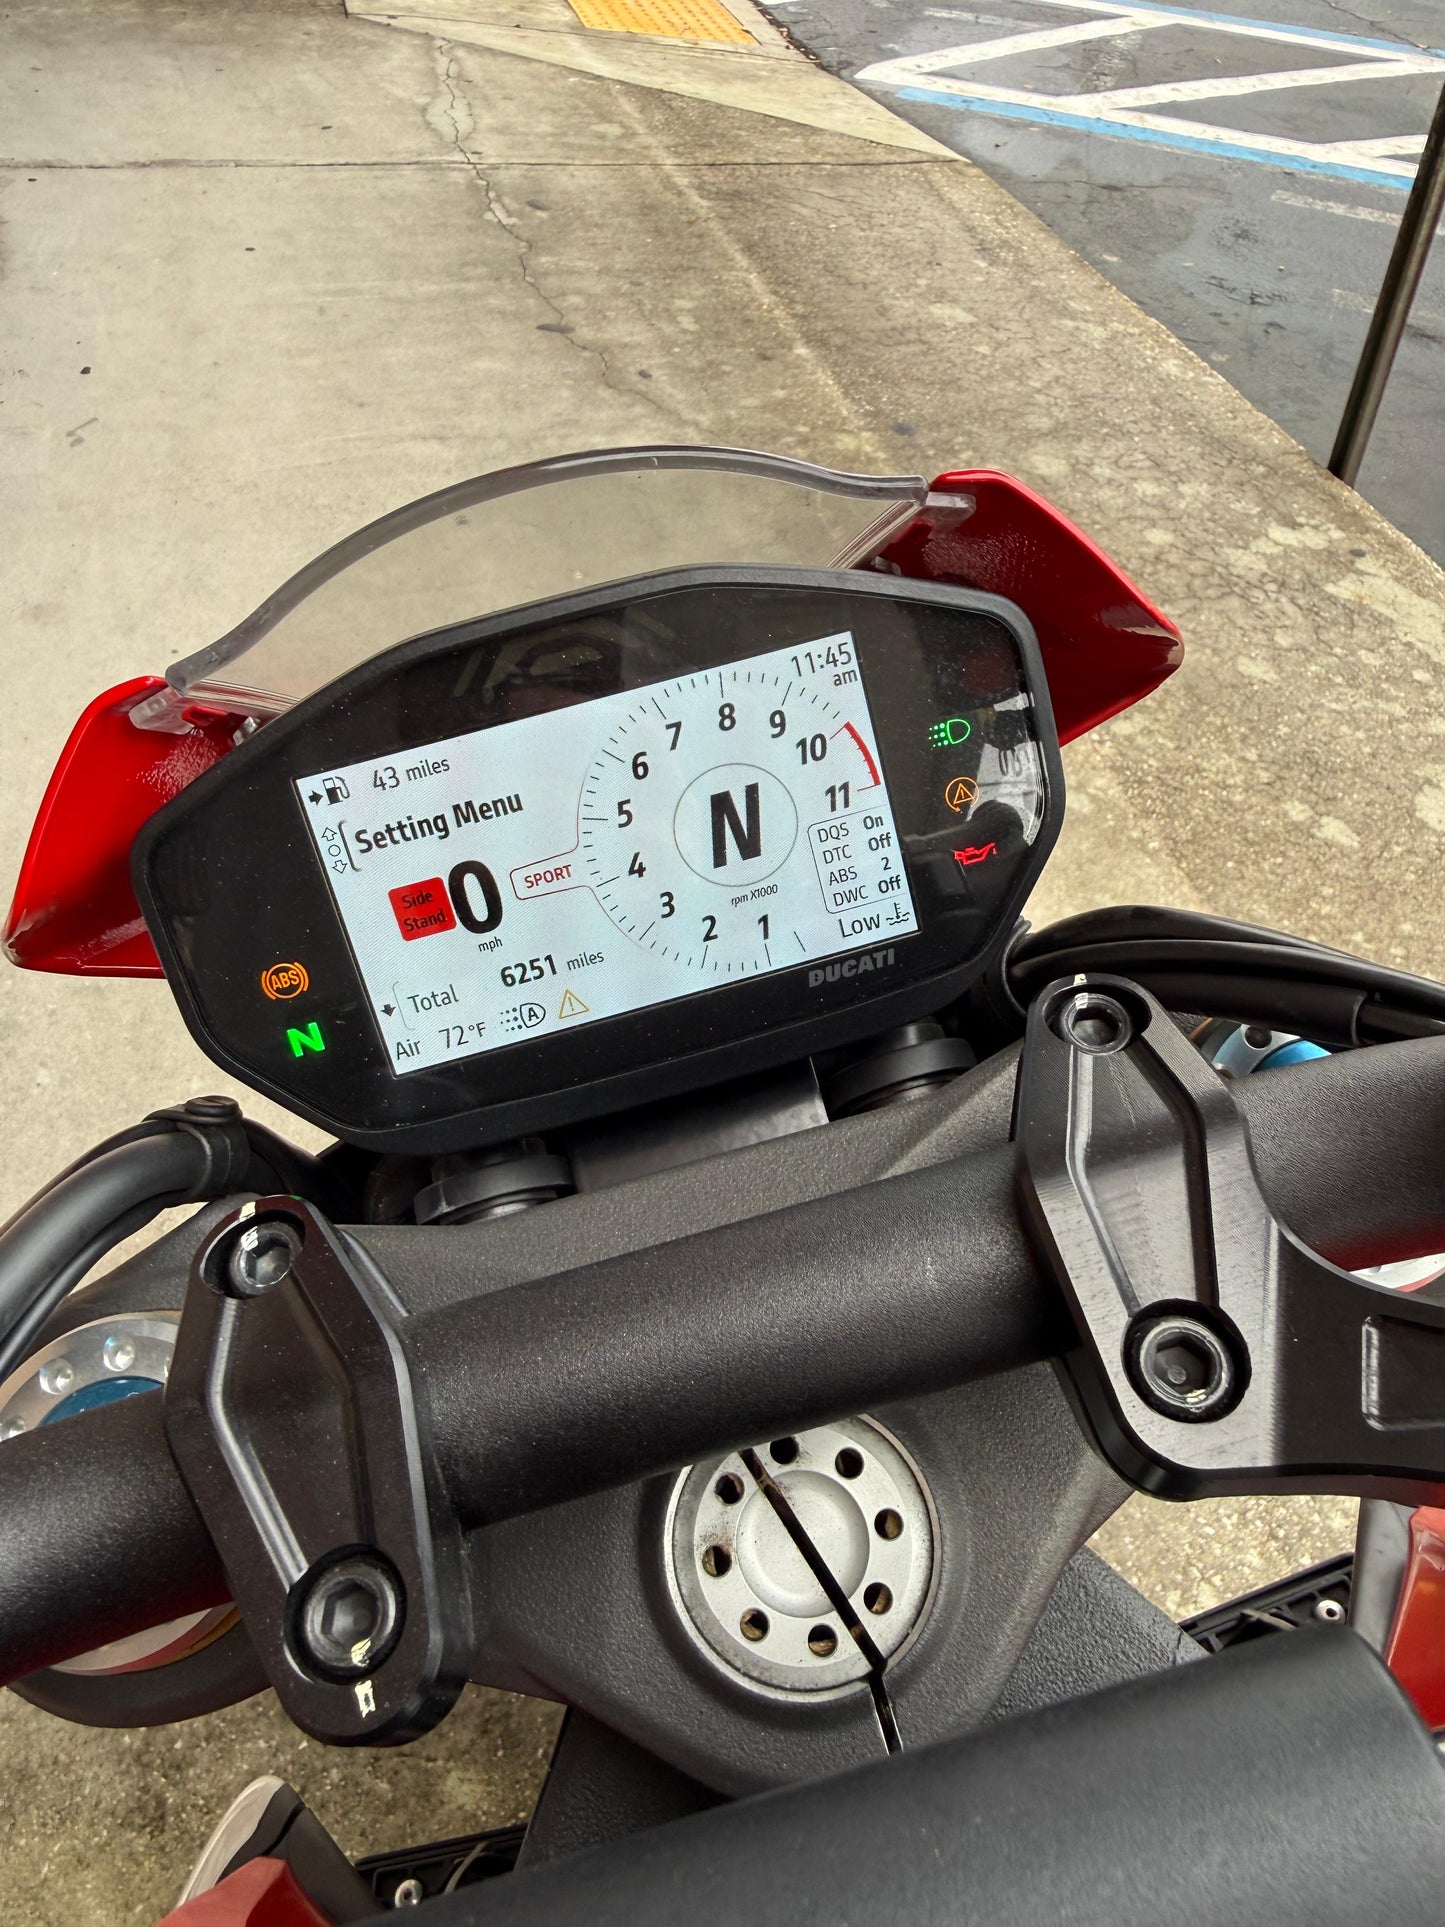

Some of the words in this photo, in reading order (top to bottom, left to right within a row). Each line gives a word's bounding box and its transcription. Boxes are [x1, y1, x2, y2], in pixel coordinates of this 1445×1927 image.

[791, 642, 852, 677] 11:45
[833, 668, 858, 687] am
[719, 703, 736, 731] 8
[769, 709, 786, 738] 9
[666, 721, 682, 751] 7
[796, 733, 827, 765] 10
[373, 766, 400, 791] 43
[406, 756, 450, 782] miles
[632, 751, 649, 780] 6
[825, 781, 850, 813] 11
[355, 813, 449, 854] Setting
[452, 793, 524, 828] Menu
[617, 799, 633, 828] 5
[710, 782, 761, 869] N
[817, 822, 849, 843] DQS
[863, 813, 884, 831] On
[823, 844, 852, 865] DTC
[868, 832, 892, 852] Off
[524, 864, 572, 889] SPORT
[628, 852, 647, 879] 4
[828, 867, 858, 887] ABS
[882, 857, 892, 871] 2
[402, 890, 434, 910] Side
[448, 860, 503, 935] 0
[659, 891, 676, 919] 3
[730, 894, 749, 907] rpm
[750, 883, 778, 901] X1000
[832, 885, 869, 907] DWC
[878, 874, 902, 894] Off
[403, 909, 447, 932] Stand
[702, 915, 718, 943] 2
[757, 914, 770, 940] 1
[838, 914, 881, 938] Low
[478, 936, 504, 953] mph
[271, 969, 300, 991] ABS
[500, 954, 558, 988] 6251
[566, 950, 604, 972] miles
[808, 948, 895, 988] DUCATI
[407, 984, 459, 1014] Total
[287, 1022, 326, 1057] N
[395, 1036, 421, 1060] Air
